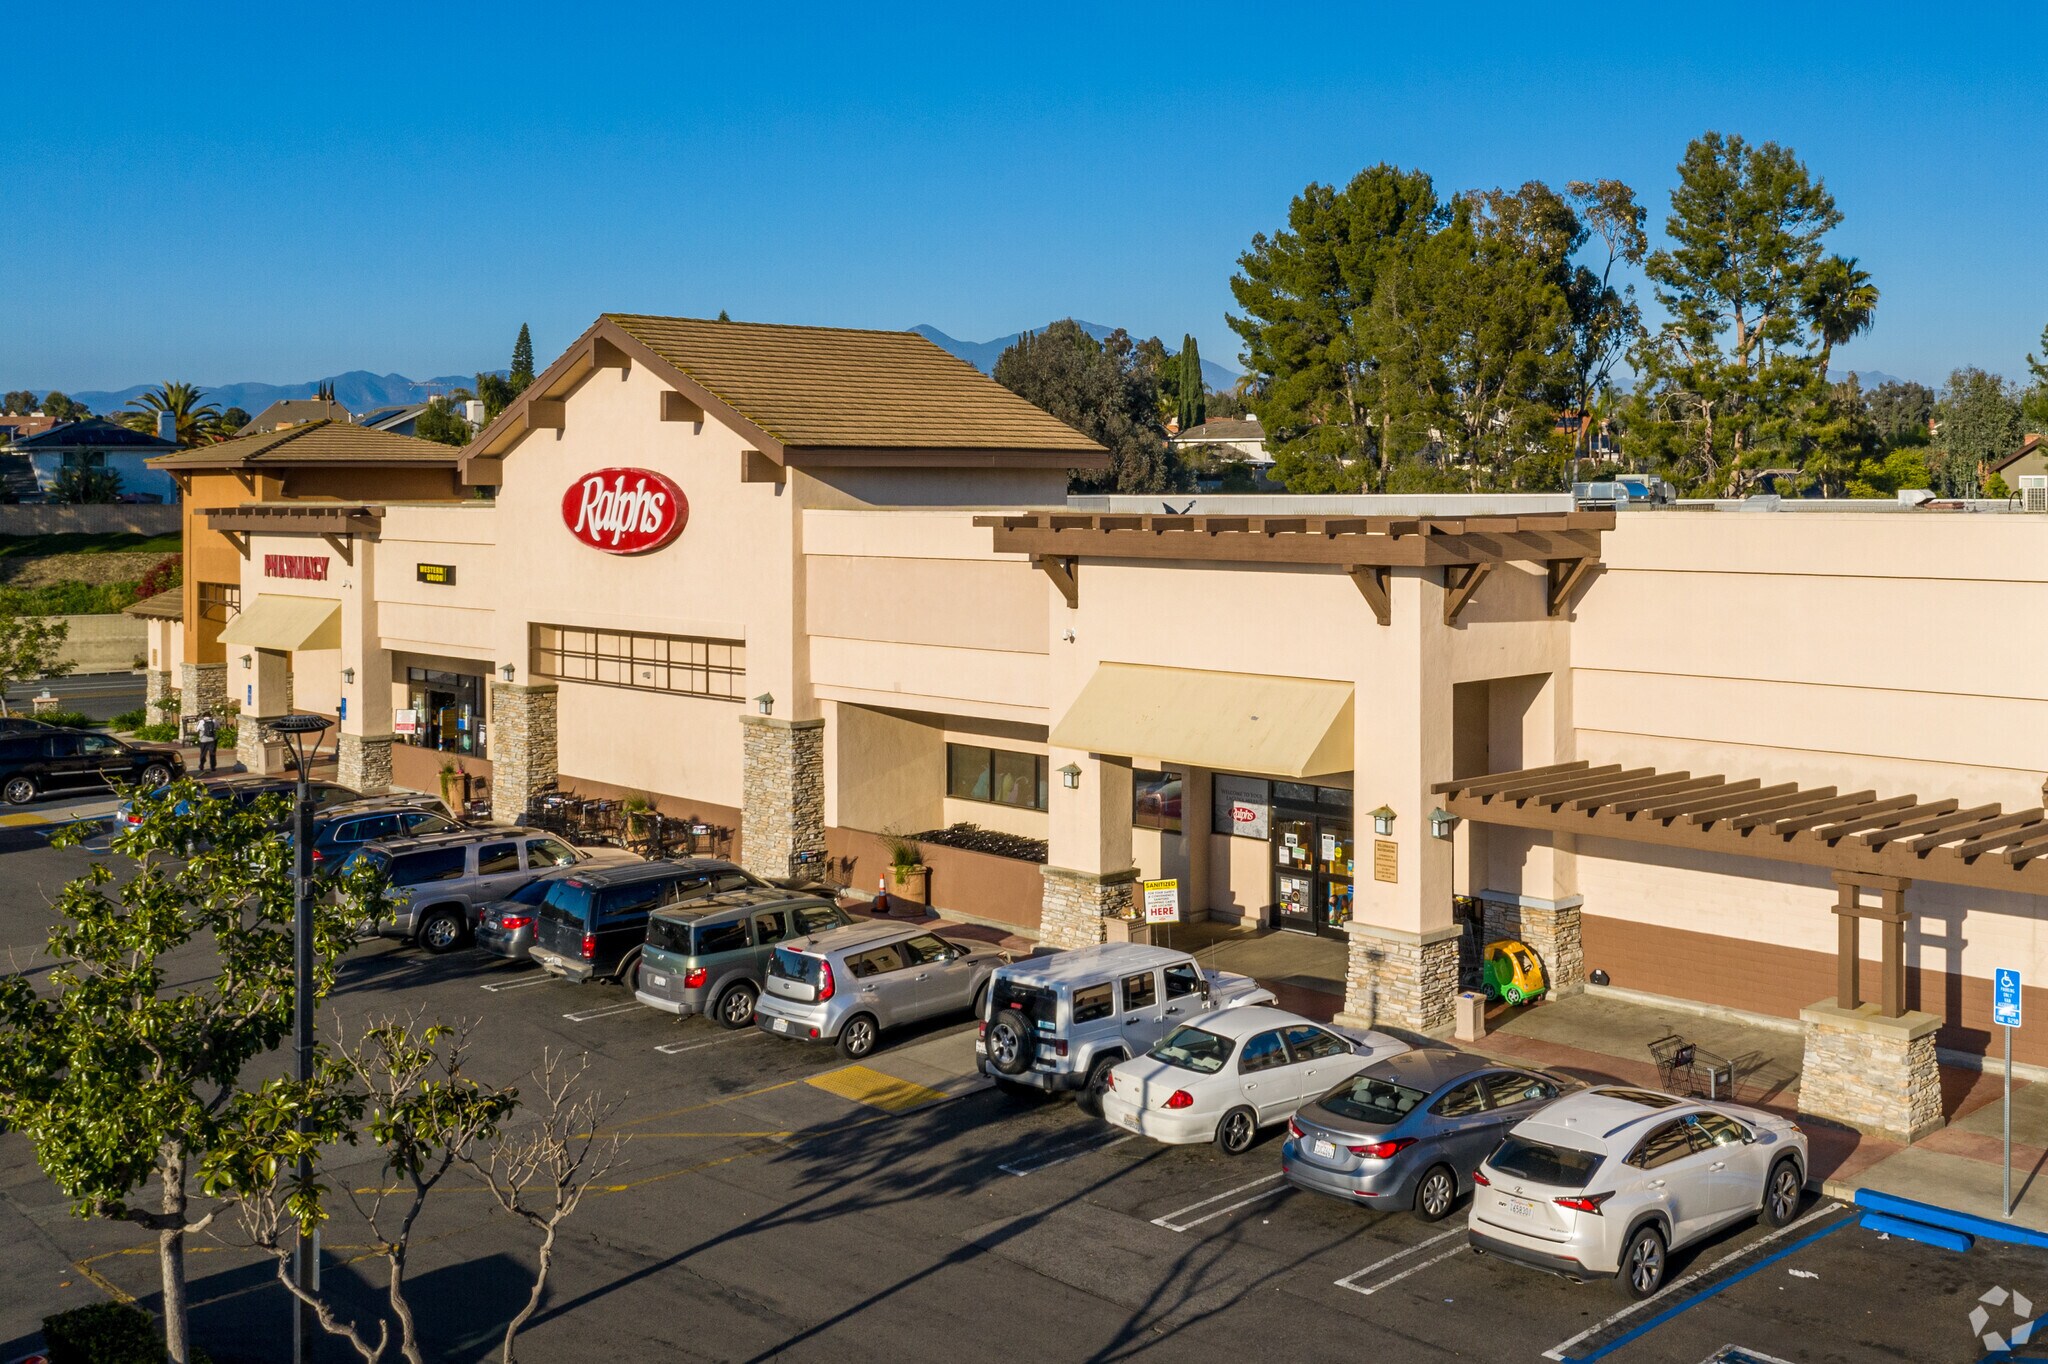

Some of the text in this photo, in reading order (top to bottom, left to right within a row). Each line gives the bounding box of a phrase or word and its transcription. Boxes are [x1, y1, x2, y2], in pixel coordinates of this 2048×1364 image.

[574, 475, 666, 546] Ralphs
[264, 554, 330, 581] PHARMACY
[419, 565, 444, 575] WESTERN
[426, 573, 444, 582] UNION
[1230, 808, 1254, 822] Ralphs
[1150, 907, 1174, 916] HERE
